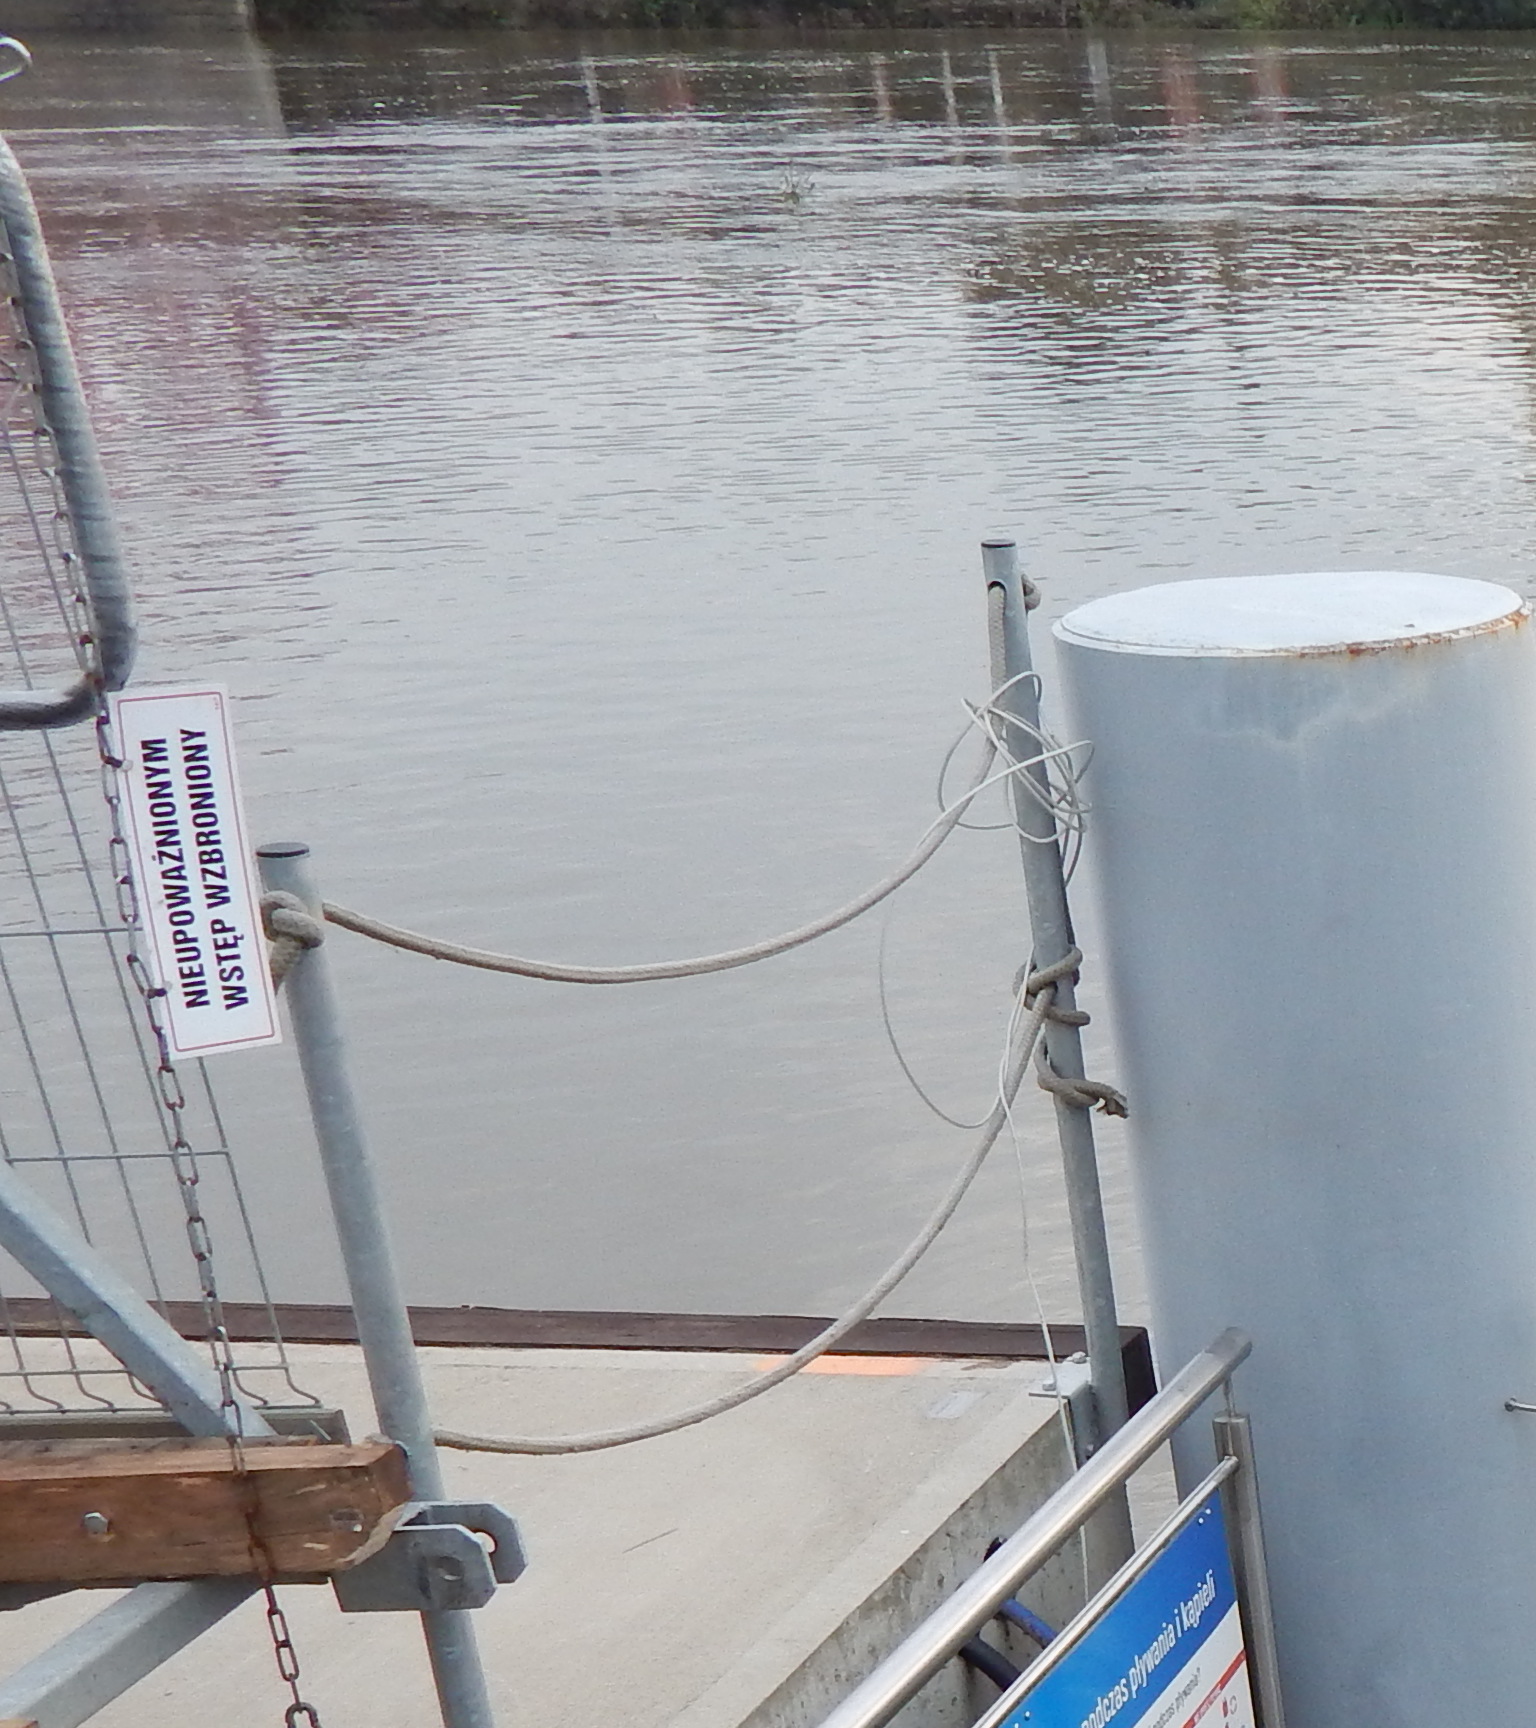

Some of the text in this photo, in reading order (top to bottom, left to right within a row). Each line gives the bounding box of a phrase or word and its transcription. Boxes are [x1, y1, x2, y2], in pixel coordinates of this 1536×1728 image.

[140, 738, 211, 1009] NIEUPOWAŻNIONYM
[179, 729, 249, 1011] WSTĘP WZBRONIONY
[1128, 1622, 1175, 1698] pływania
[1174, 1608, 1181, 1637] i
[1180, 1569, 1215, 1630] kąpieli
